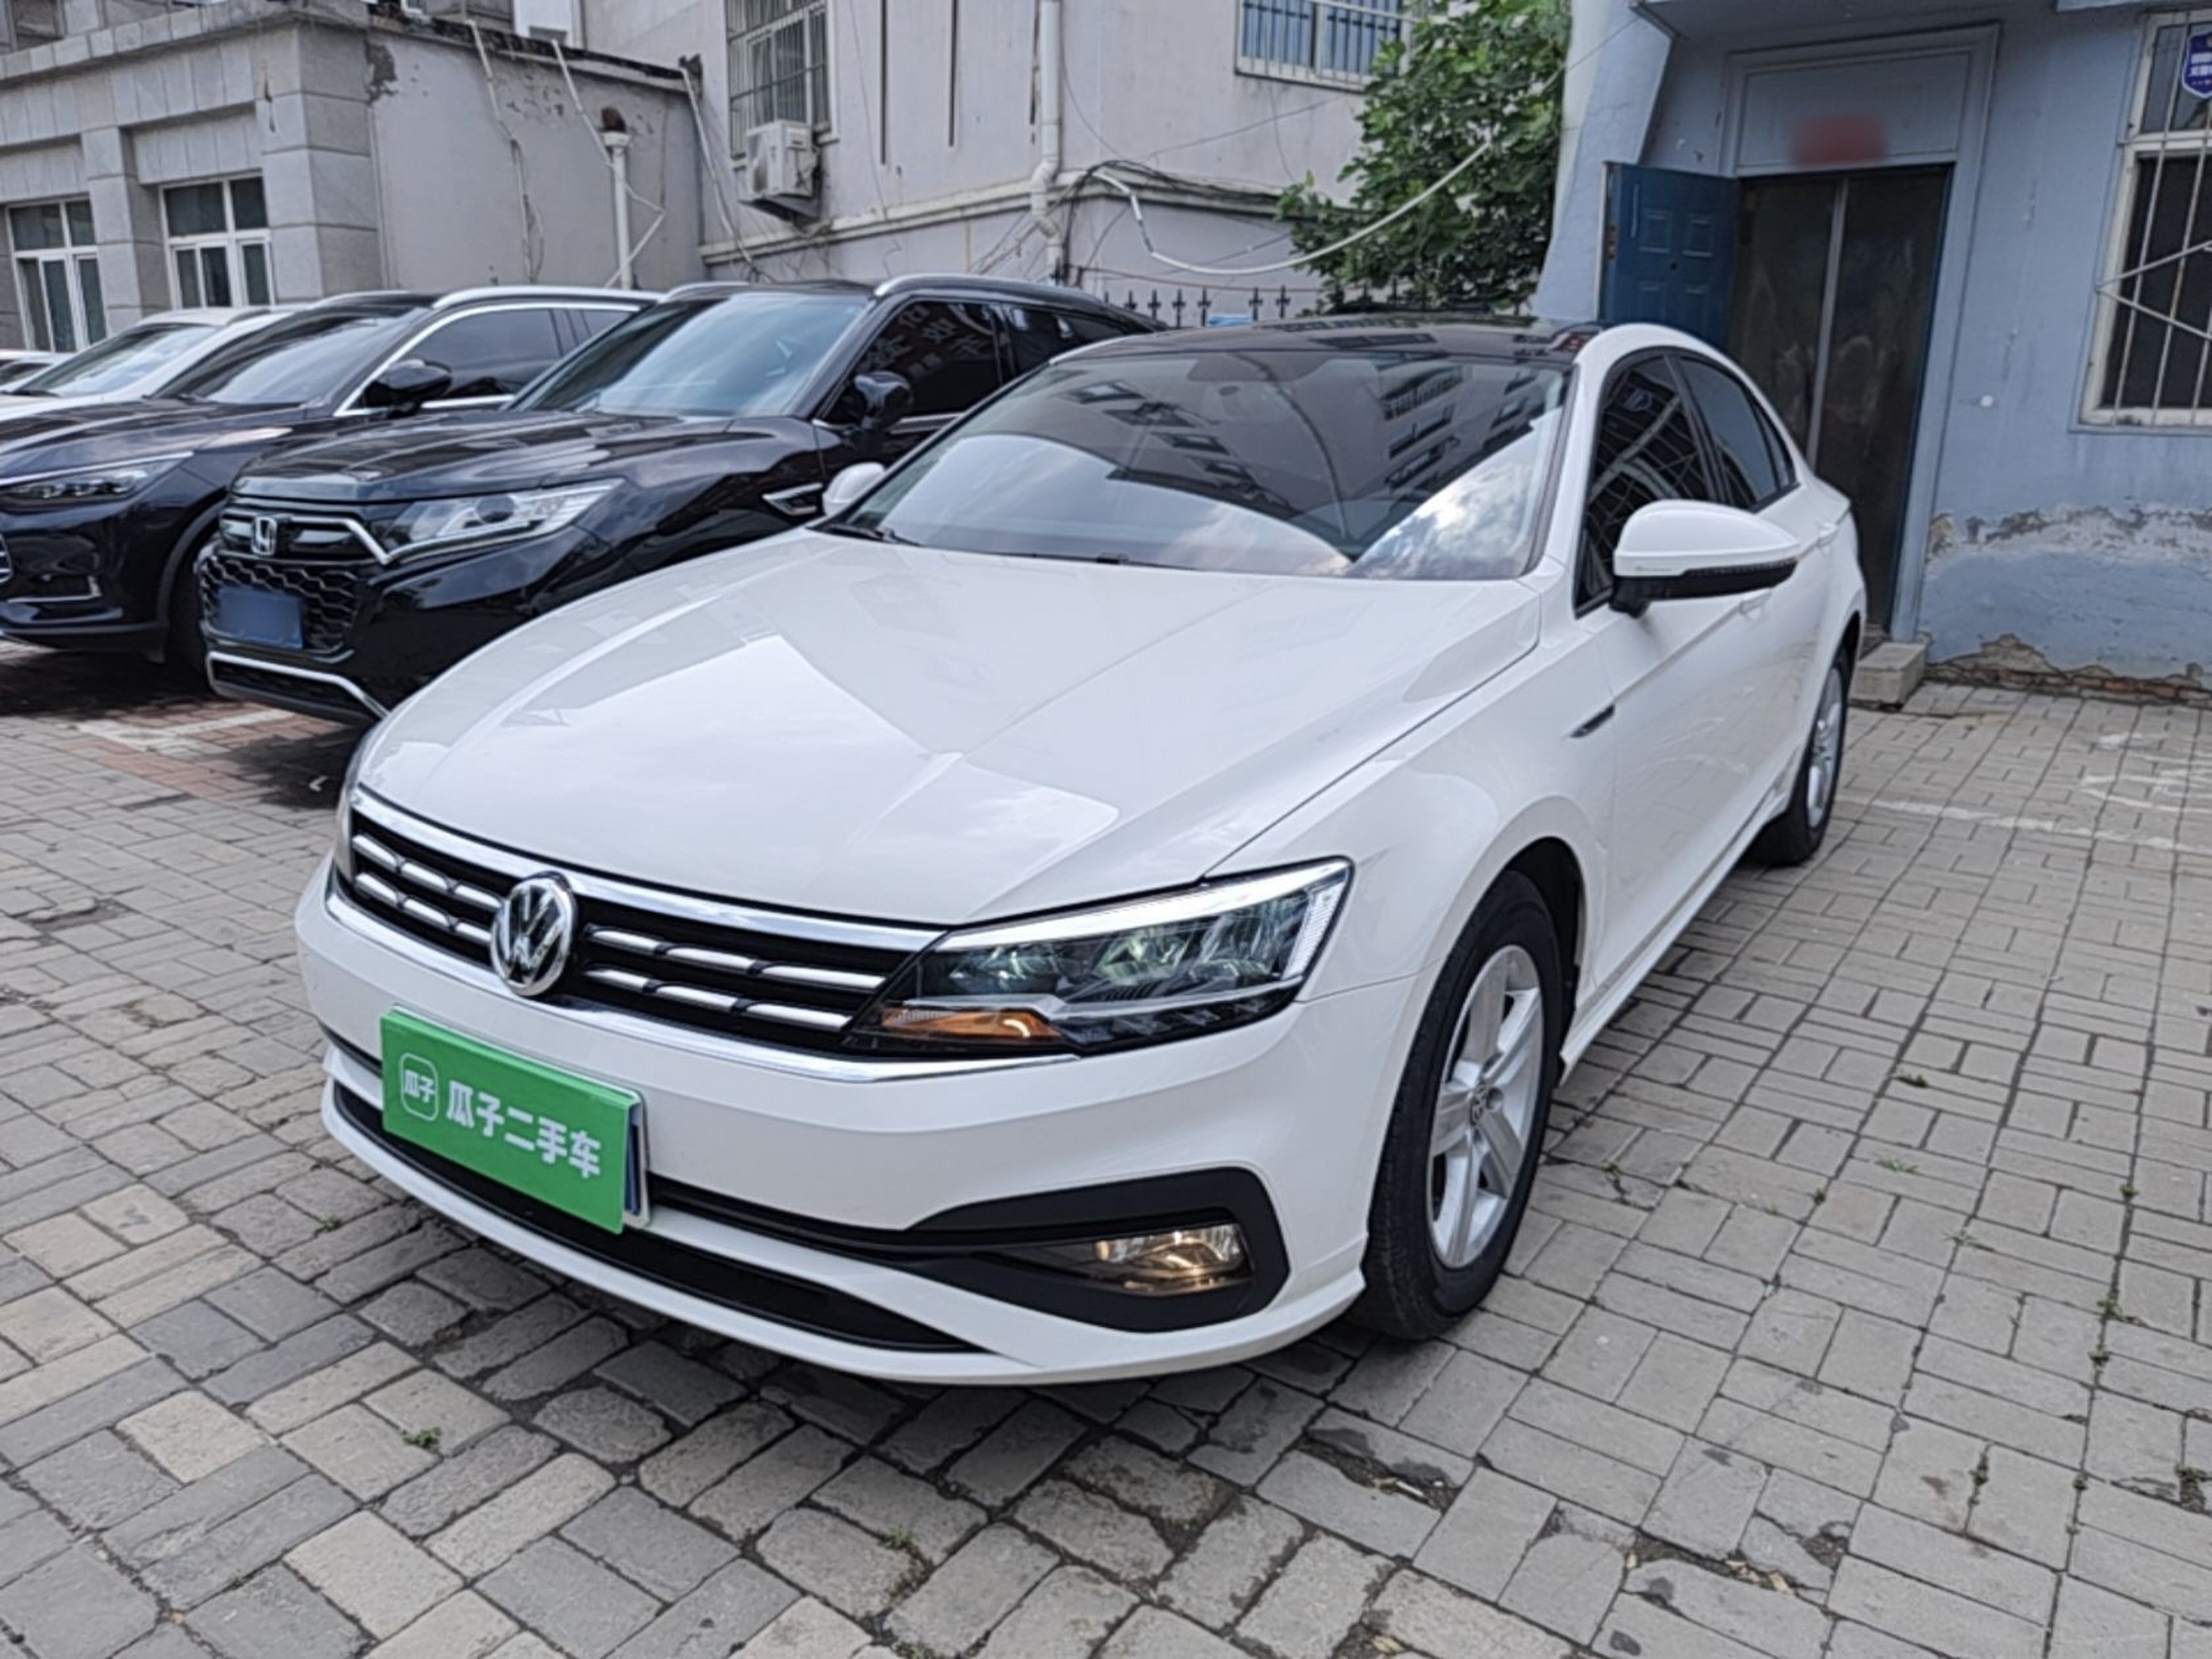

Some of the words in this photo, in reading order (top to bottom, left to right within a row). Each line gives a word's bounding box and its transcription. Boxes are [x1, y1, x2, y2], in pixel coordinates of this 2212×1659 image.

[404, 1069, 436, 1103] 瓜子
[446, 1080, 601, 1179] 瓜子二手车
